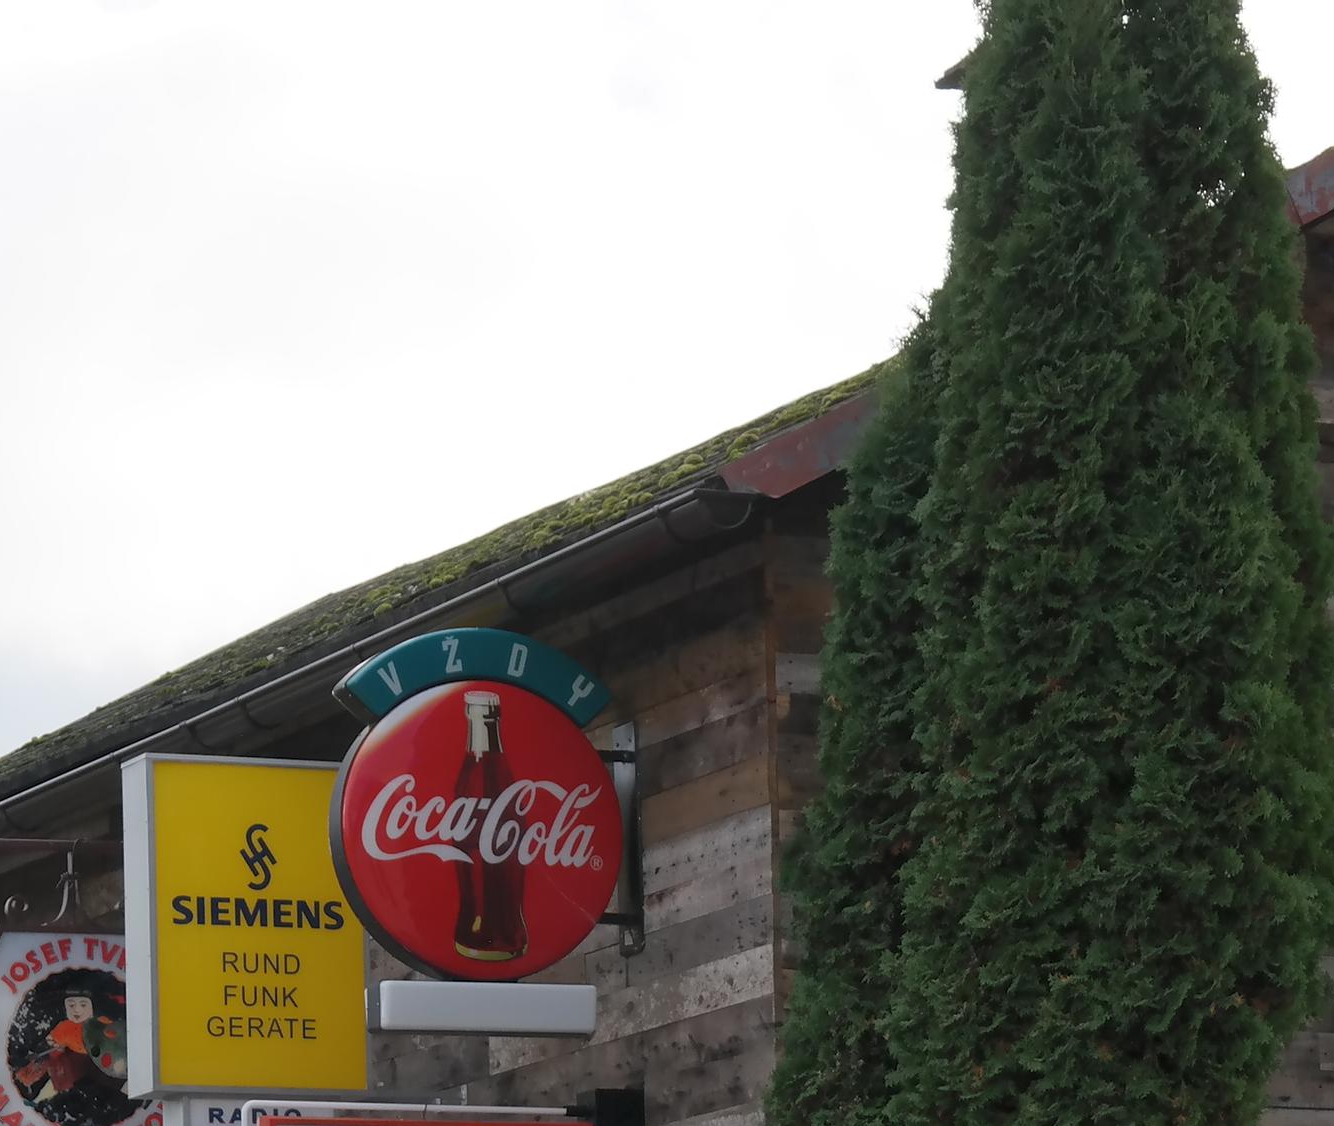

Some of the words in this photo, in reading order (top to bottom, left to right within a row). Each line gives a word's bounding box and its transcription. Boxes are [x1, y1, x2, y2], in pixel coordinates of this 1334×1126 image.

[377, 635, 595, 707] VŽDY
[361, 773, 602, 868] Coca-Cola
[171, 894, 345, 931] SIEMENS
[0, 937, 73, 995] JOSEF
[221, 951, 302, 976] RUND
[223, 984, 299, 1008] FUNK
[206, 1015, 318, 1040] GERÄTE
